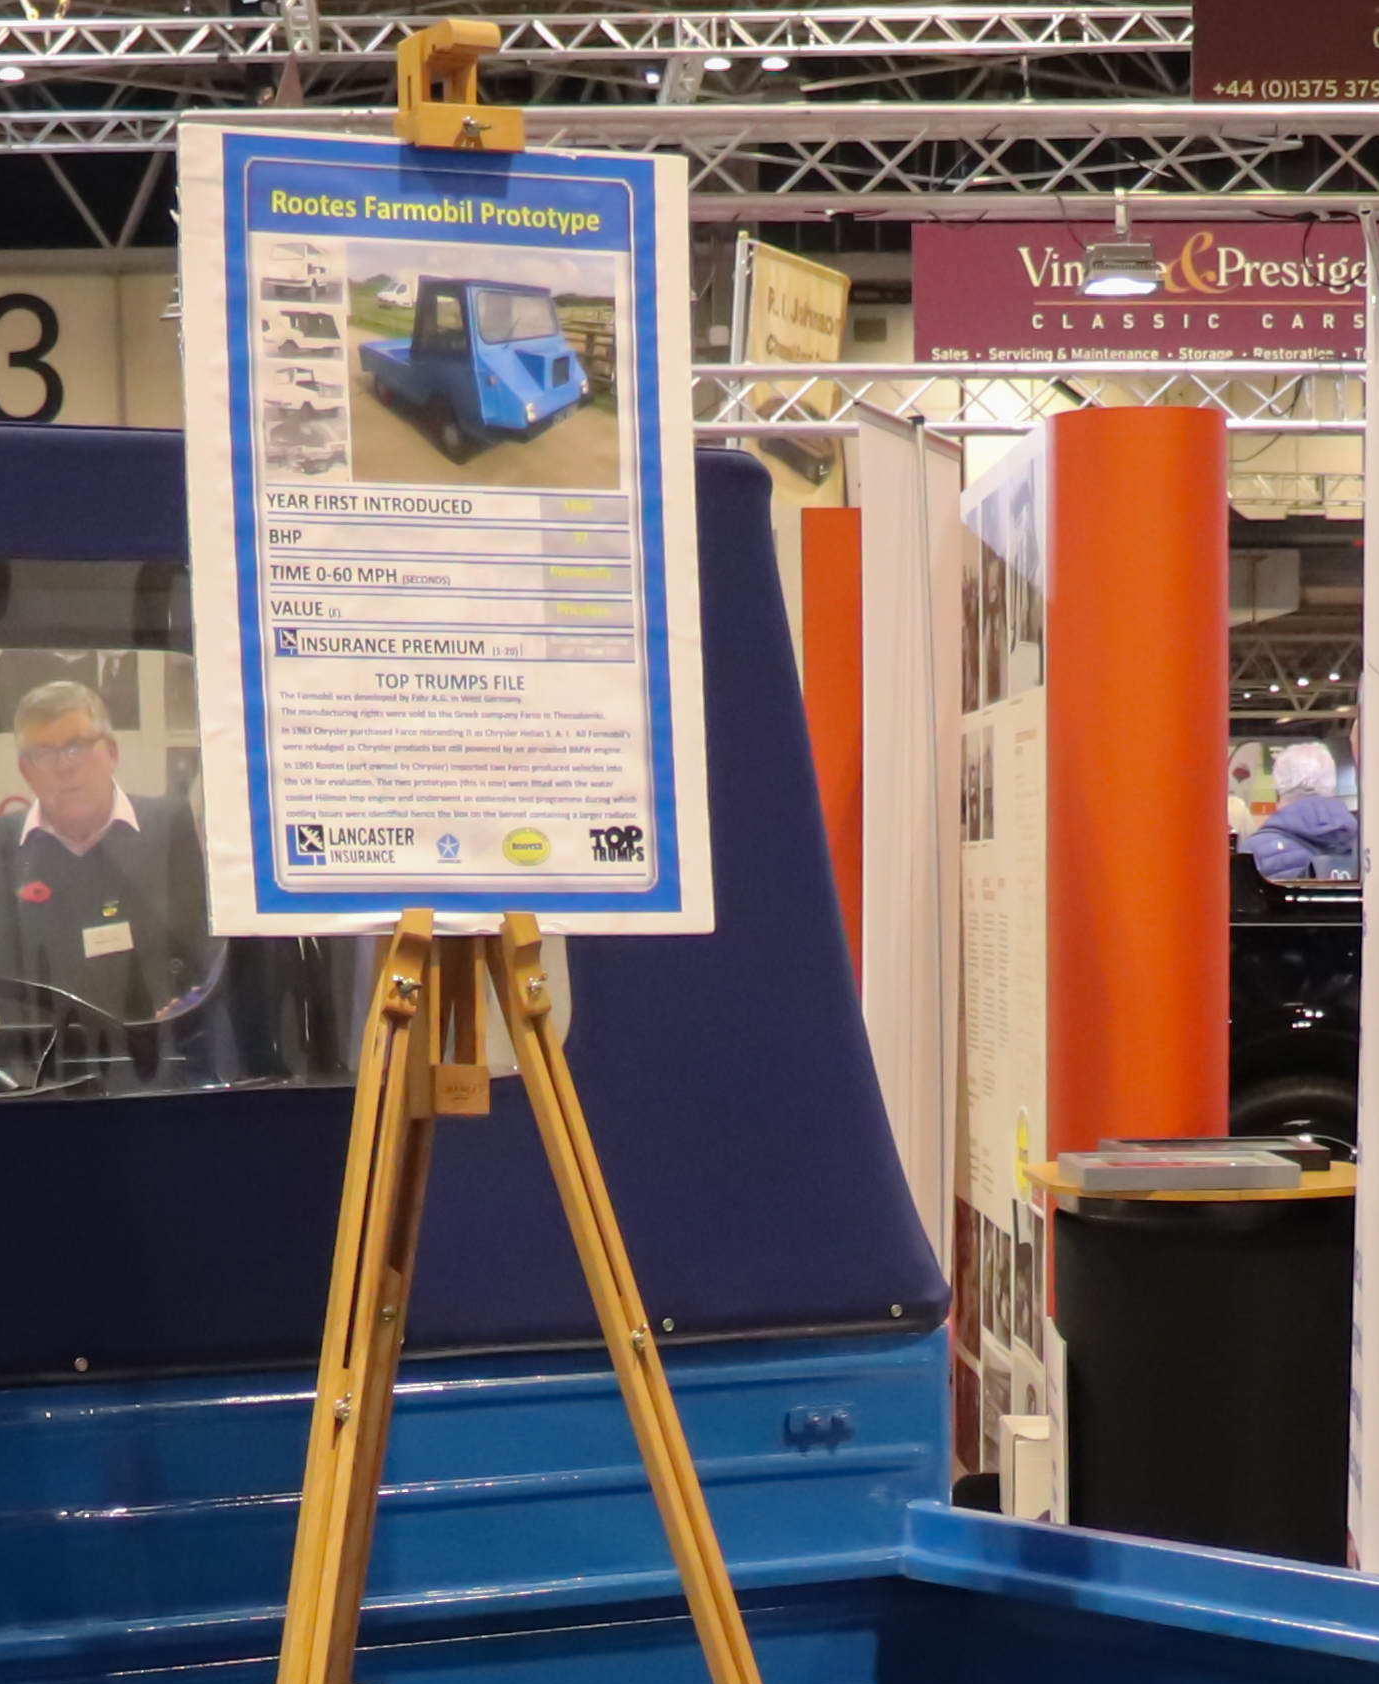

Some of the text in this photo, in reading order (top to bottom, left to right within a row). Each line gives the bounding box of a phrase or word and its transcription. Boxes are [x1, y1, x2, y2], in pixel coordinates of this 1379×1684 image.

[1213, 80, 1254, 97] +44
[1261, 80, 1338, 99] (0)1375
[272, 190, 599, 235] Rootes Farmobil Prototype
[1032, 314, 1364, 329] CLASSIC CARS
[932, 347, 969, 361] Sales
[989, 348, 1053, 363] Servicing
[1057, 348, 1067, 361] &
[1071, 348, 1159, 361] Maintenance
[1179, 348, 1233, 361] Storage
[1253, 347, 1334, 361] Restoration
[266, 493, 472, 514] YEAR FIRST INTRODUCED
[269, 529, 302, 544] BHP
[271, 565, 450, 586] TIME 0-60 MPH (SECONDS)
[271, 600, 323, 616] VALUE
[301, 637, 396, 653] INSURANCE
[403, 639, 485, 655] PREMIUM
[375, 673, 525, 691] TOP TRUMPS FILE
[329, 828, 414, 846] LANCASTER
[589, 826, 644, 849] TOP
[330, 850, 396, 864] INSURANCE
[592, 846, 644, 862] TRUMPS
